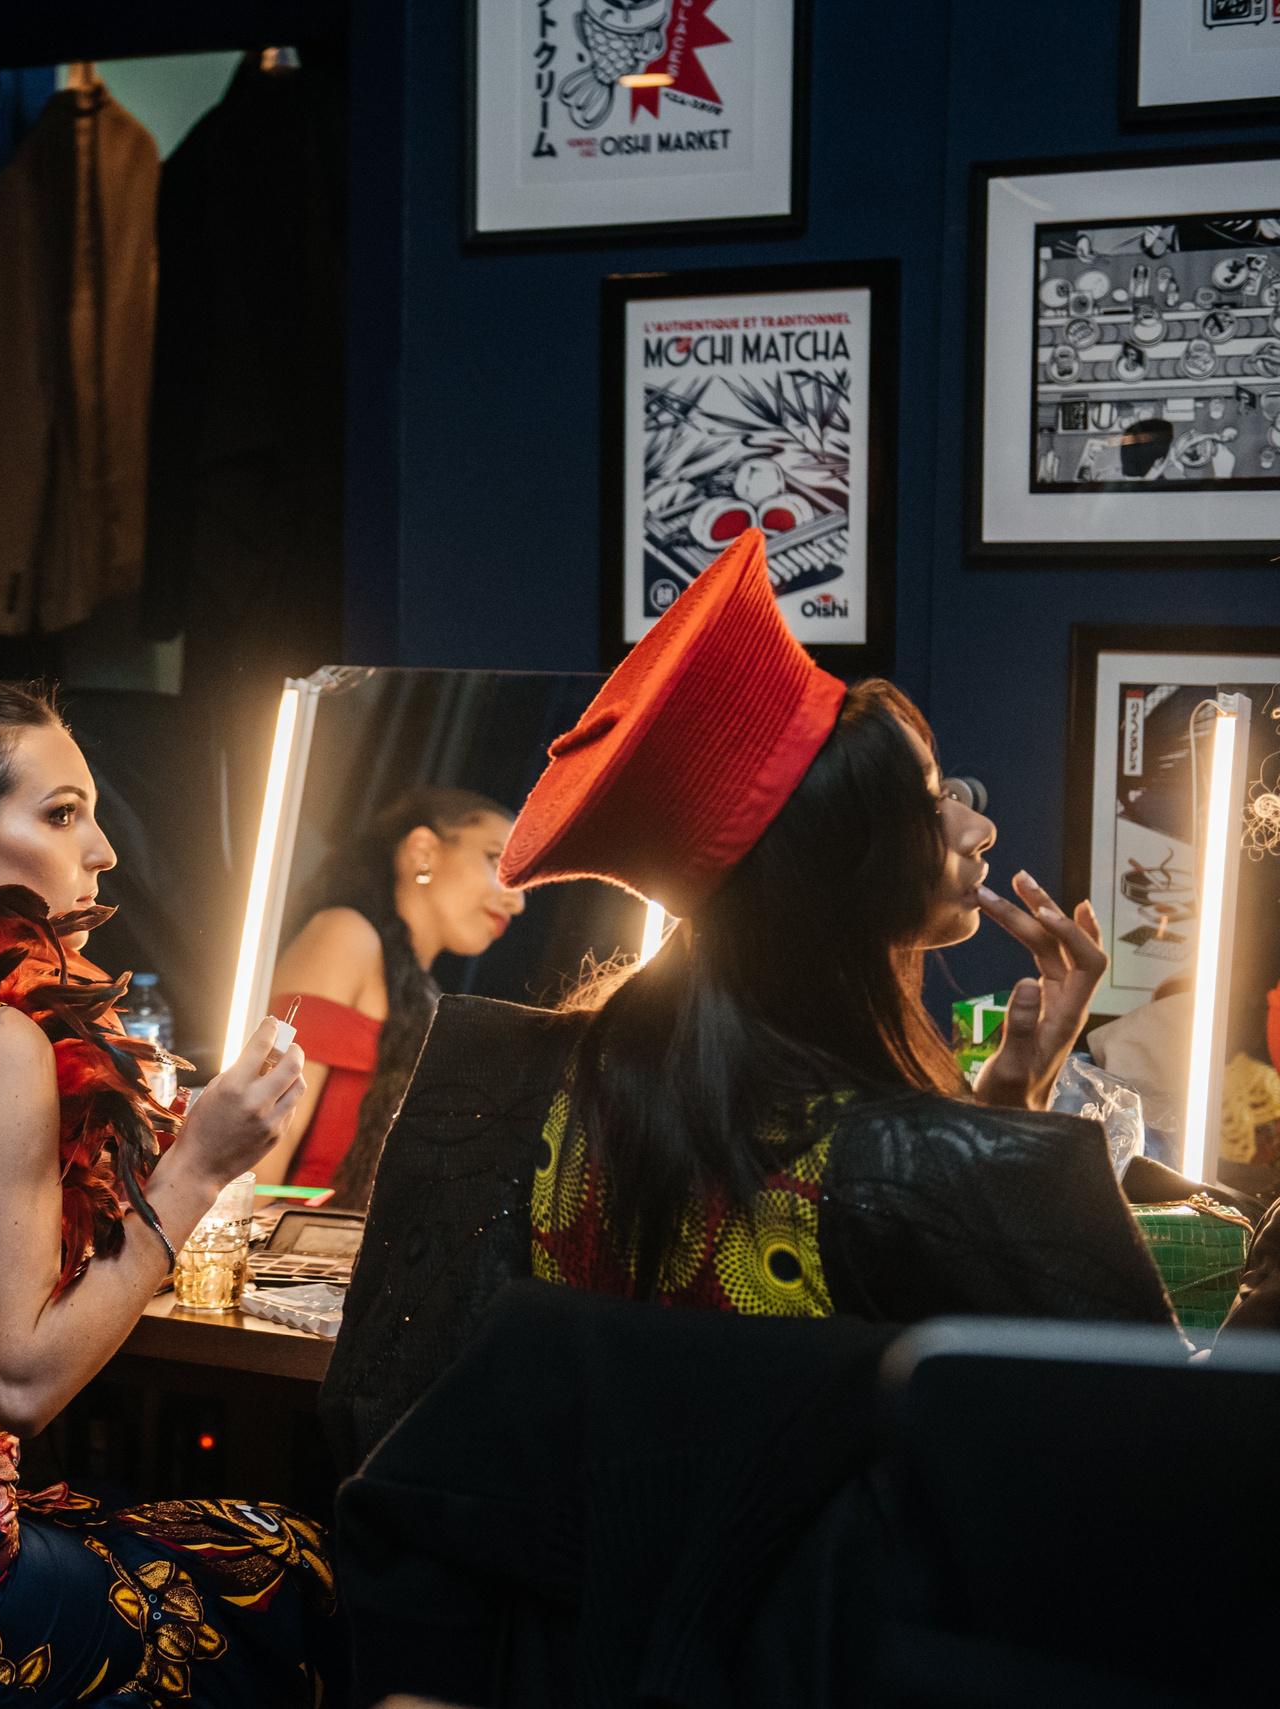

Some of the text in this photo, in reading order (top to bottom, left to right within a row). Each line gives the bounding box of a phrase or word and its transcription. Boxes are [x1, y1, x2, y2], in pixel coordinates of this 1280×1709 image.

[600, 133, 651, 156] OISHI
[658, 128, 731, 153] MARKET
[644, 312, 851, 334] L'AUTHENTIQUE ET TRADITIONNEL
[644, 329, 851, 368] MOCHI MATCHA
[801, 599, 849, 618] Oishi
